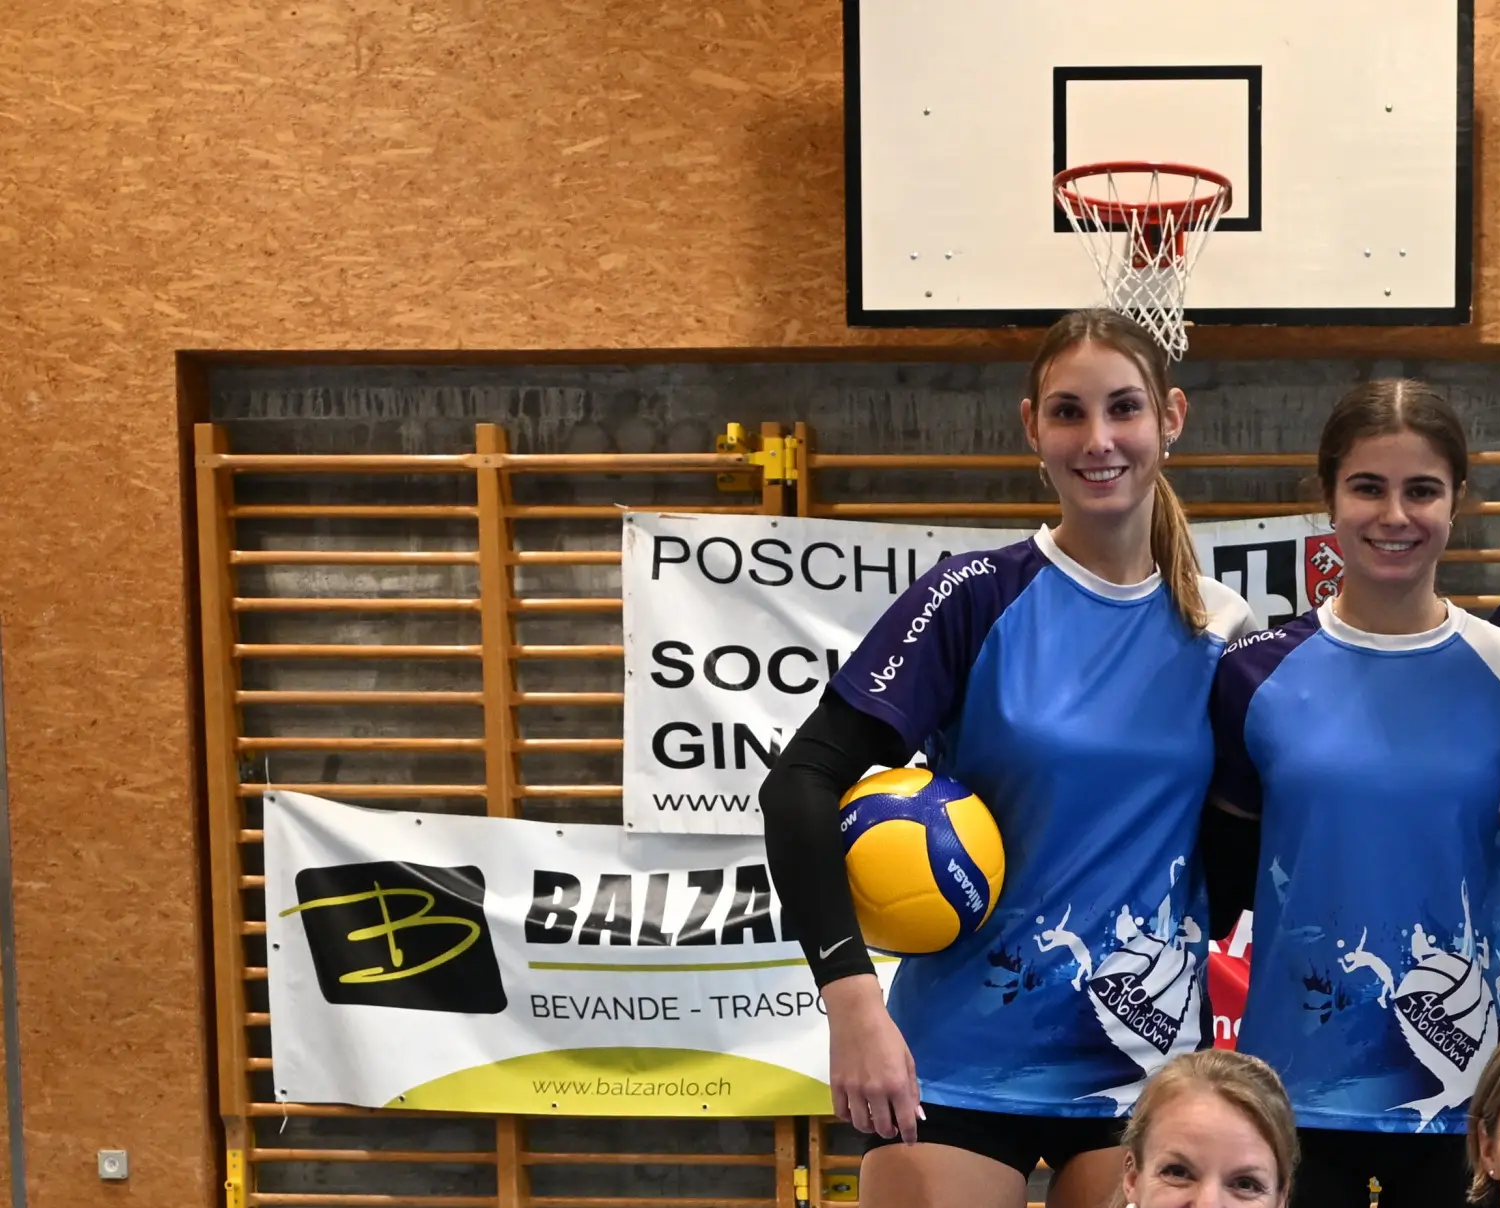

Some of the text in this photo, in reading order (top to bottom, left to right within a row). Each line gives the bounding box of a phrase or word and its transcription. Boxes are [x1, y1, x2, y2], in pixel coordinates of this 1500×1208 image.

[651, 536, 953, 595] POSCHI
[869, 556, 997, 694] vbc randolinas
[650, 640, 854, 695] SOCI
[652, 721, 801, 770] GIN
[524, 863, 801, 947] BALZA
[530, 994, 680, 1021] BEVANDE
[532, 1077, 732, 1097] www.balzarolo.ch
